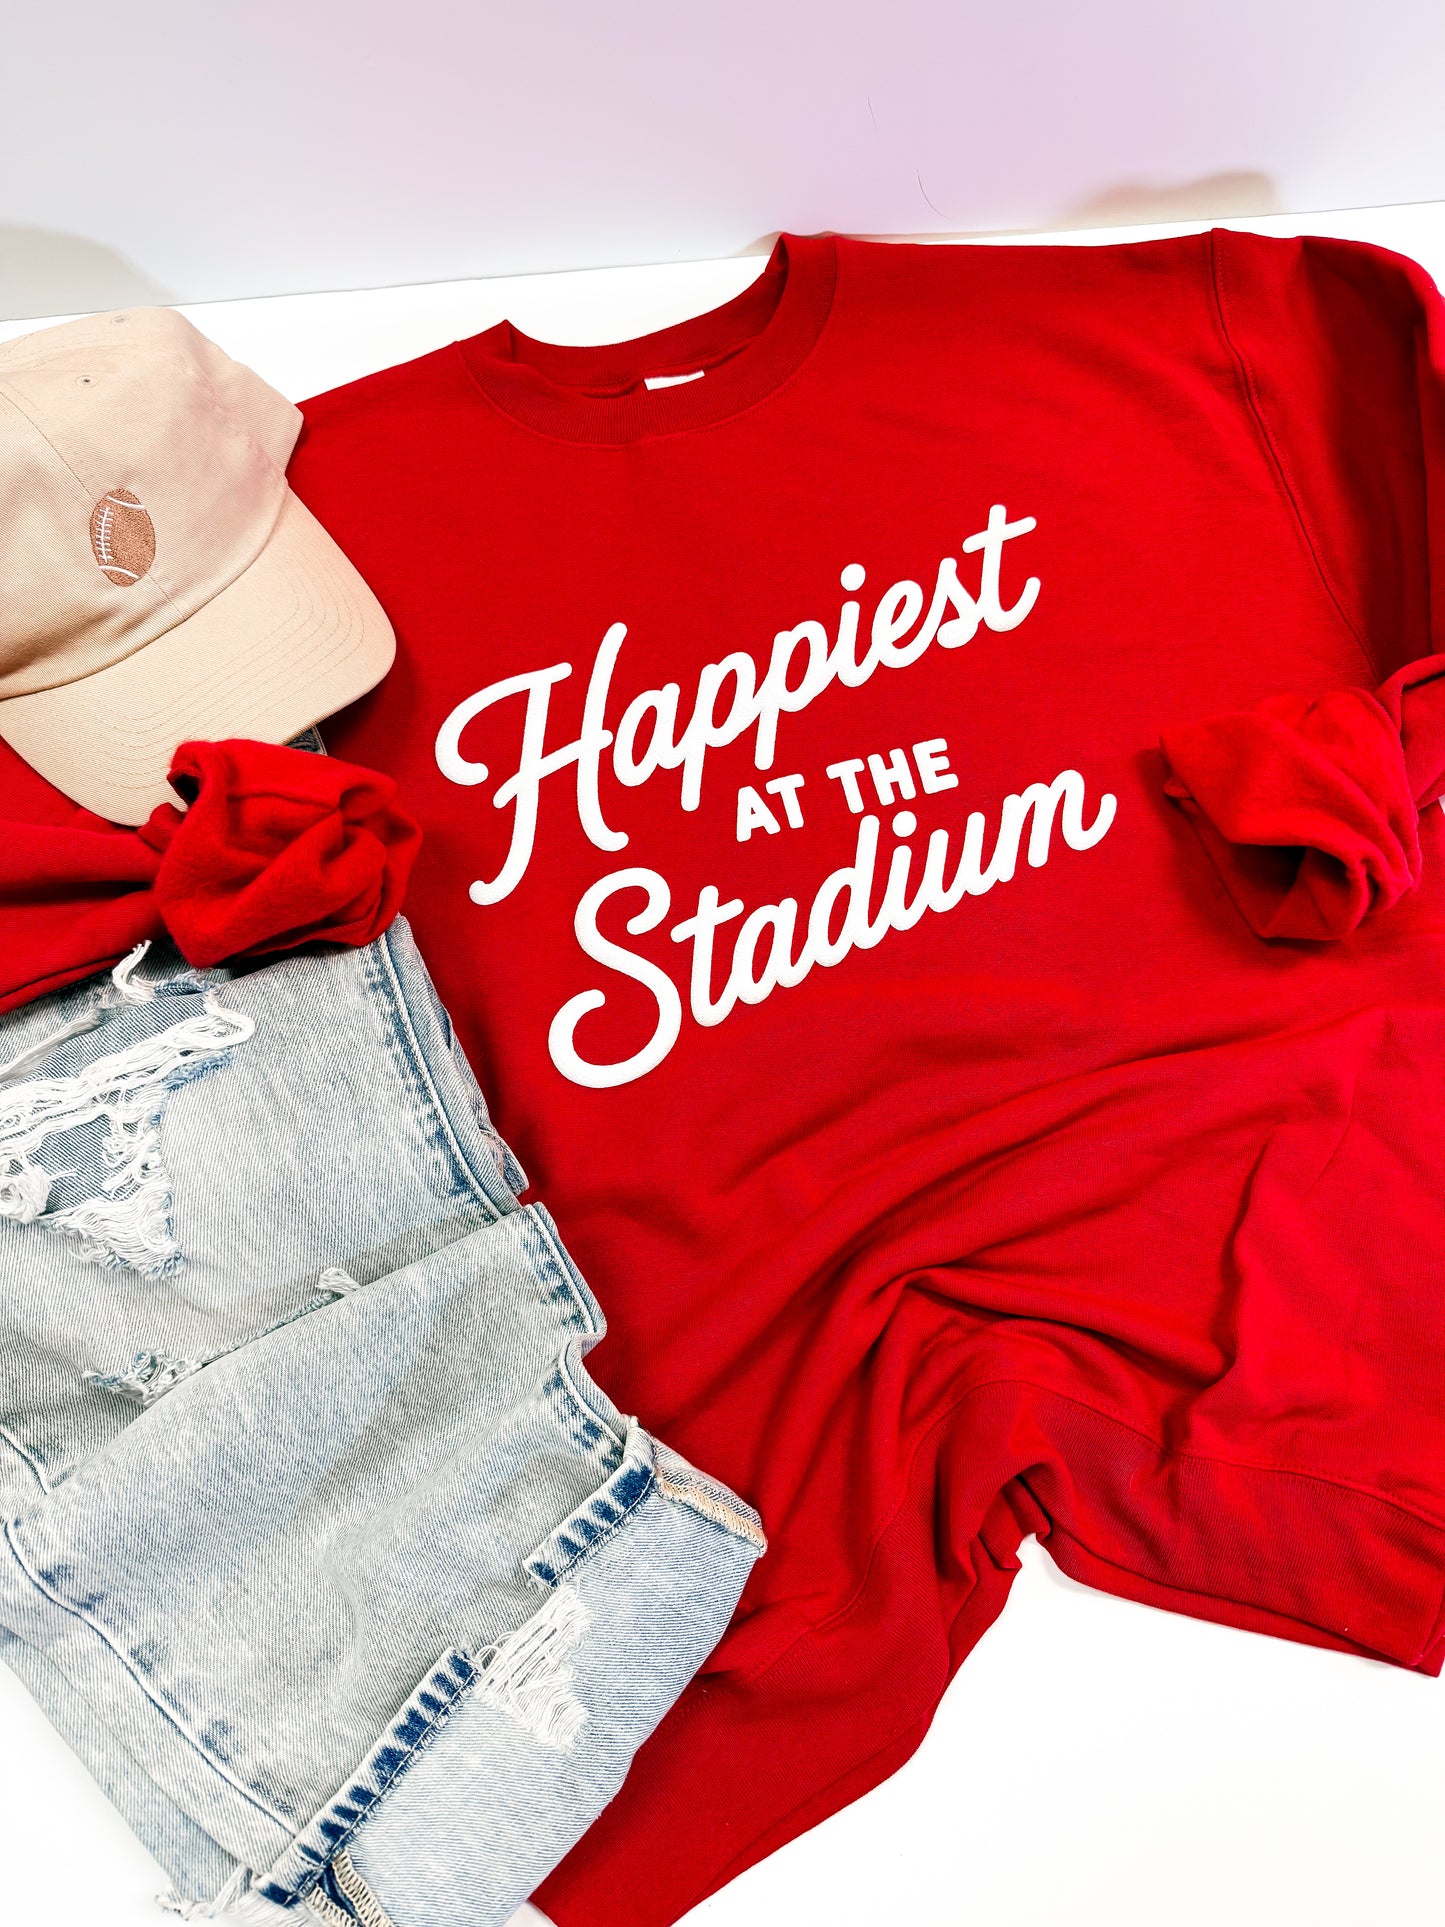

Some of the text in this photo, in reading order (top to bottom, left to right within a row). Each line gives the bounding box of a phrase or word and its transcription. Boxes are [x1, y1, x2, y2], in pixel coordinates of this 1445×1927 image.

[434, 504, 1041, 906] Happiest
[736, 737, 960, 843] AT THE
[547, 769, 1118, 1089] Stadium
